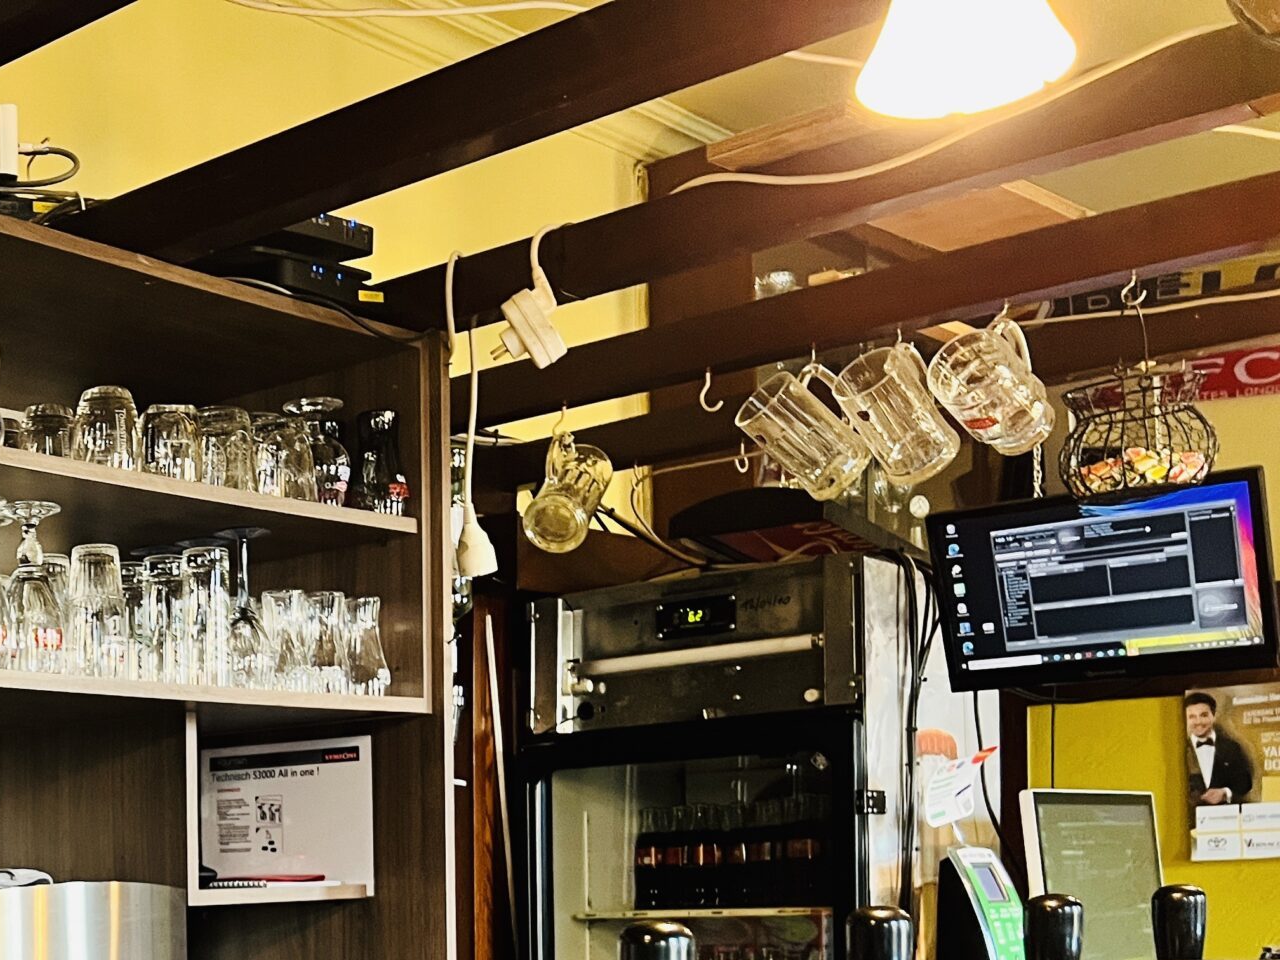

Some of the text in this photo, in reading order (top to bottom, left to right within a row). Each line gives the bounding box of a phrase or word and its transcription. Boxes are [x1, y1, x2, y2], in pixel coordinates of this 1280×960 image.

[211, 770, 251, 784] Technisch
[252, 769, 276, 780] S3000
[278, 769, 289, 779] All
[290, 768, 298, 778] in
[299, 768, 315, 777] one
